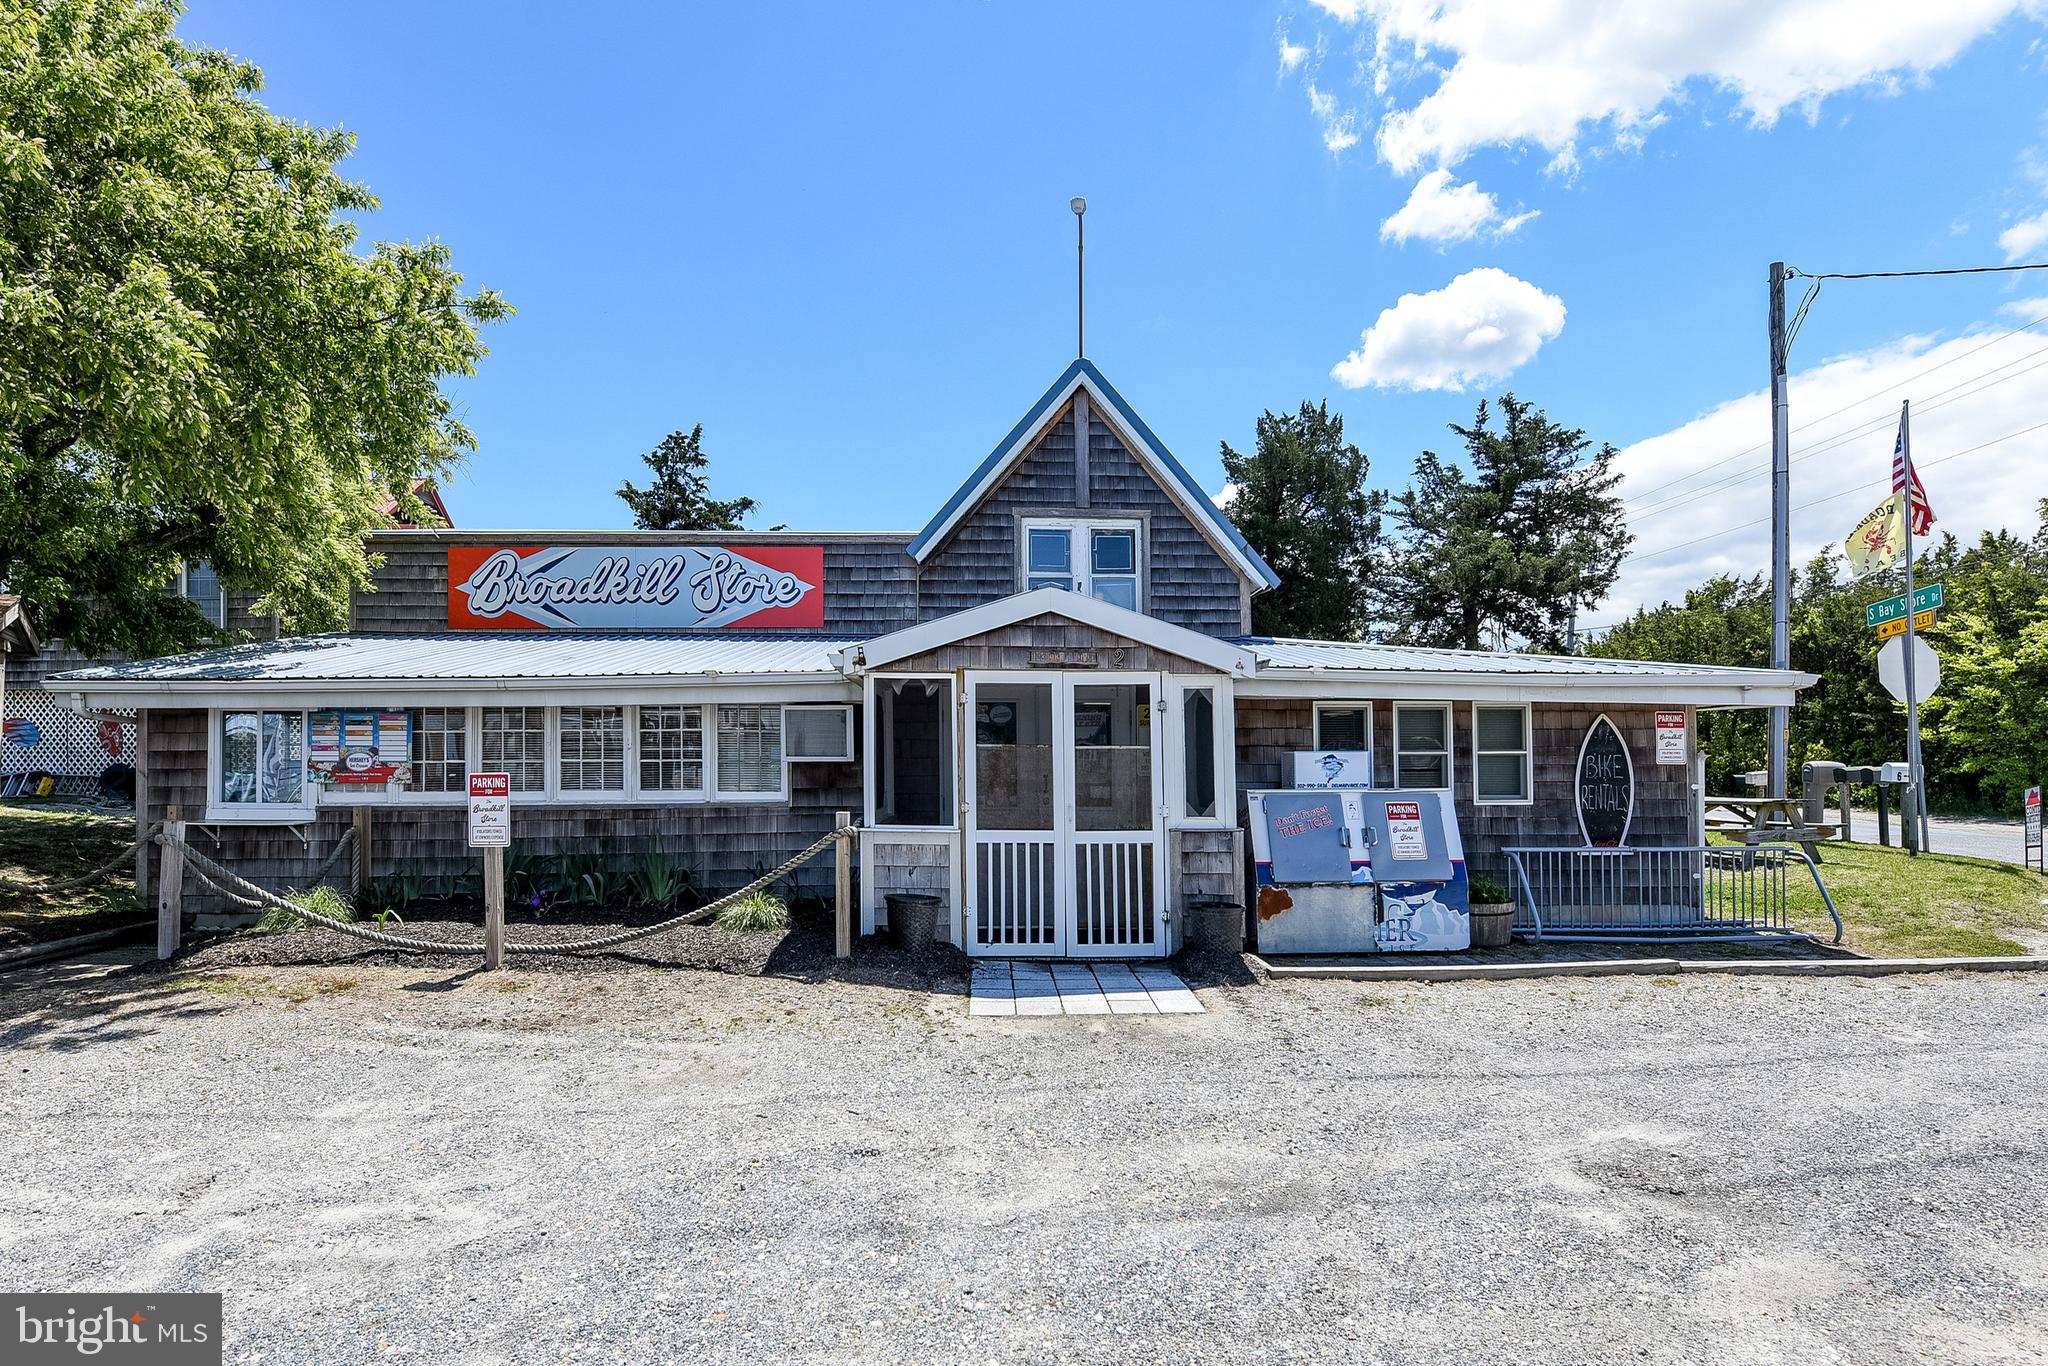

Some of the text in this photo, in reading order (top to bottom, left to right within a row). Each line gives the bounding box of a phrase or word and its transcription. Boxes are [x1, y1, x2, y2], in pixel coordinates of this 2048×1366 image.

[471, 552, 802, 613] Broadkill Store
[1869, 608, 1875, 620] S
[1878, 603, 1895, 617] Bay
[1931, 592, 1940, 602] Dr
[1891, 613, 1931, 632] NO OTLET
[1113, 648, 1125, 667] 2
[1657, 714, 1683, 723] PARKING
[1585, 754, 1624, 779] BIKE
[472, 777, 506, 788] PARKING
[1581, 783, 1630, 813] RENTALS
[473, 803, 506, 814] Broadkill
[1274, 804, 1329, 827] Don't Forget
[1388, 804, 1417, 814] PARKING
[480, 813, 498, 824] Store
[1278, 815, 1334, 840] THE ICE!
